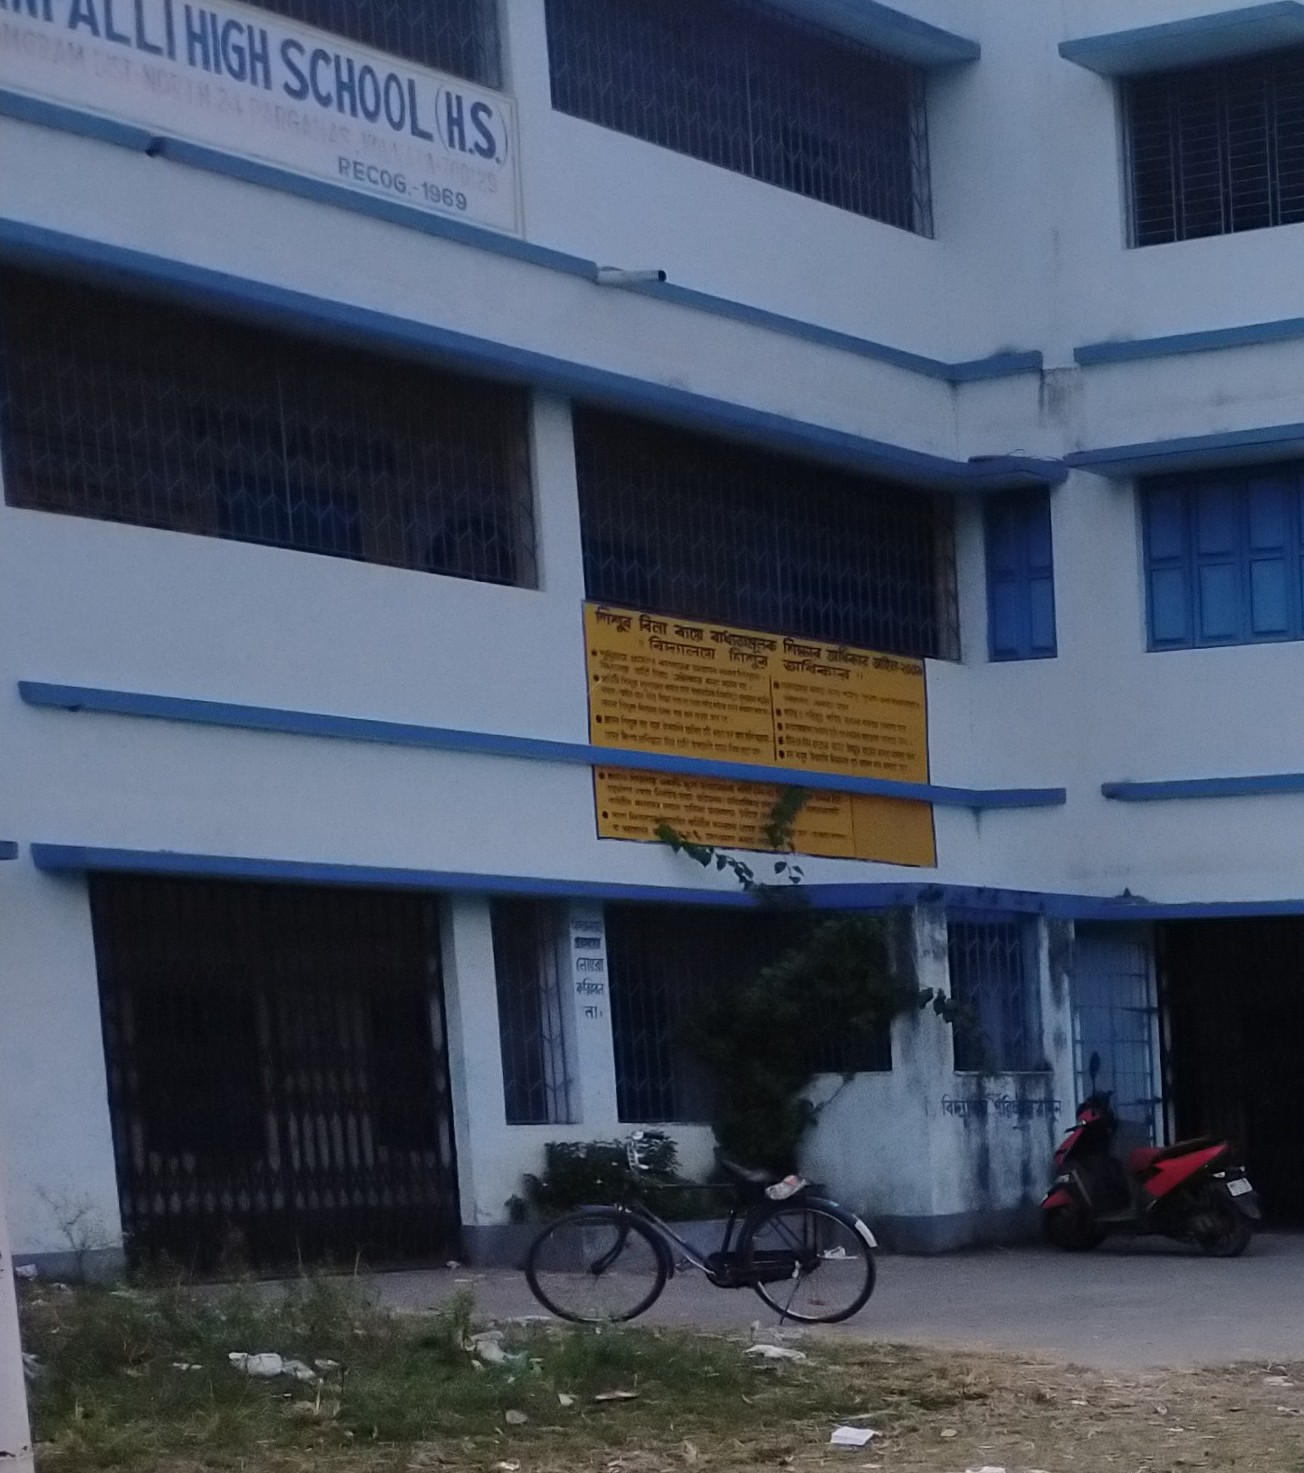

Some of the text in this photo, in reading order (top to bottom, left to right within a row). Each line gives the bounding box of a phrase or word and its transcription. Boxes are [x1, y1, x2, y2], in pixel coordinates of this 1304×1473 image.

[185, 4, 272, 91] HIGH
[280, 38, 434, 143] SCHOOL
[435, 83, 508, 170] (H.S.)
[639, 614, 669, 635] বিনা
